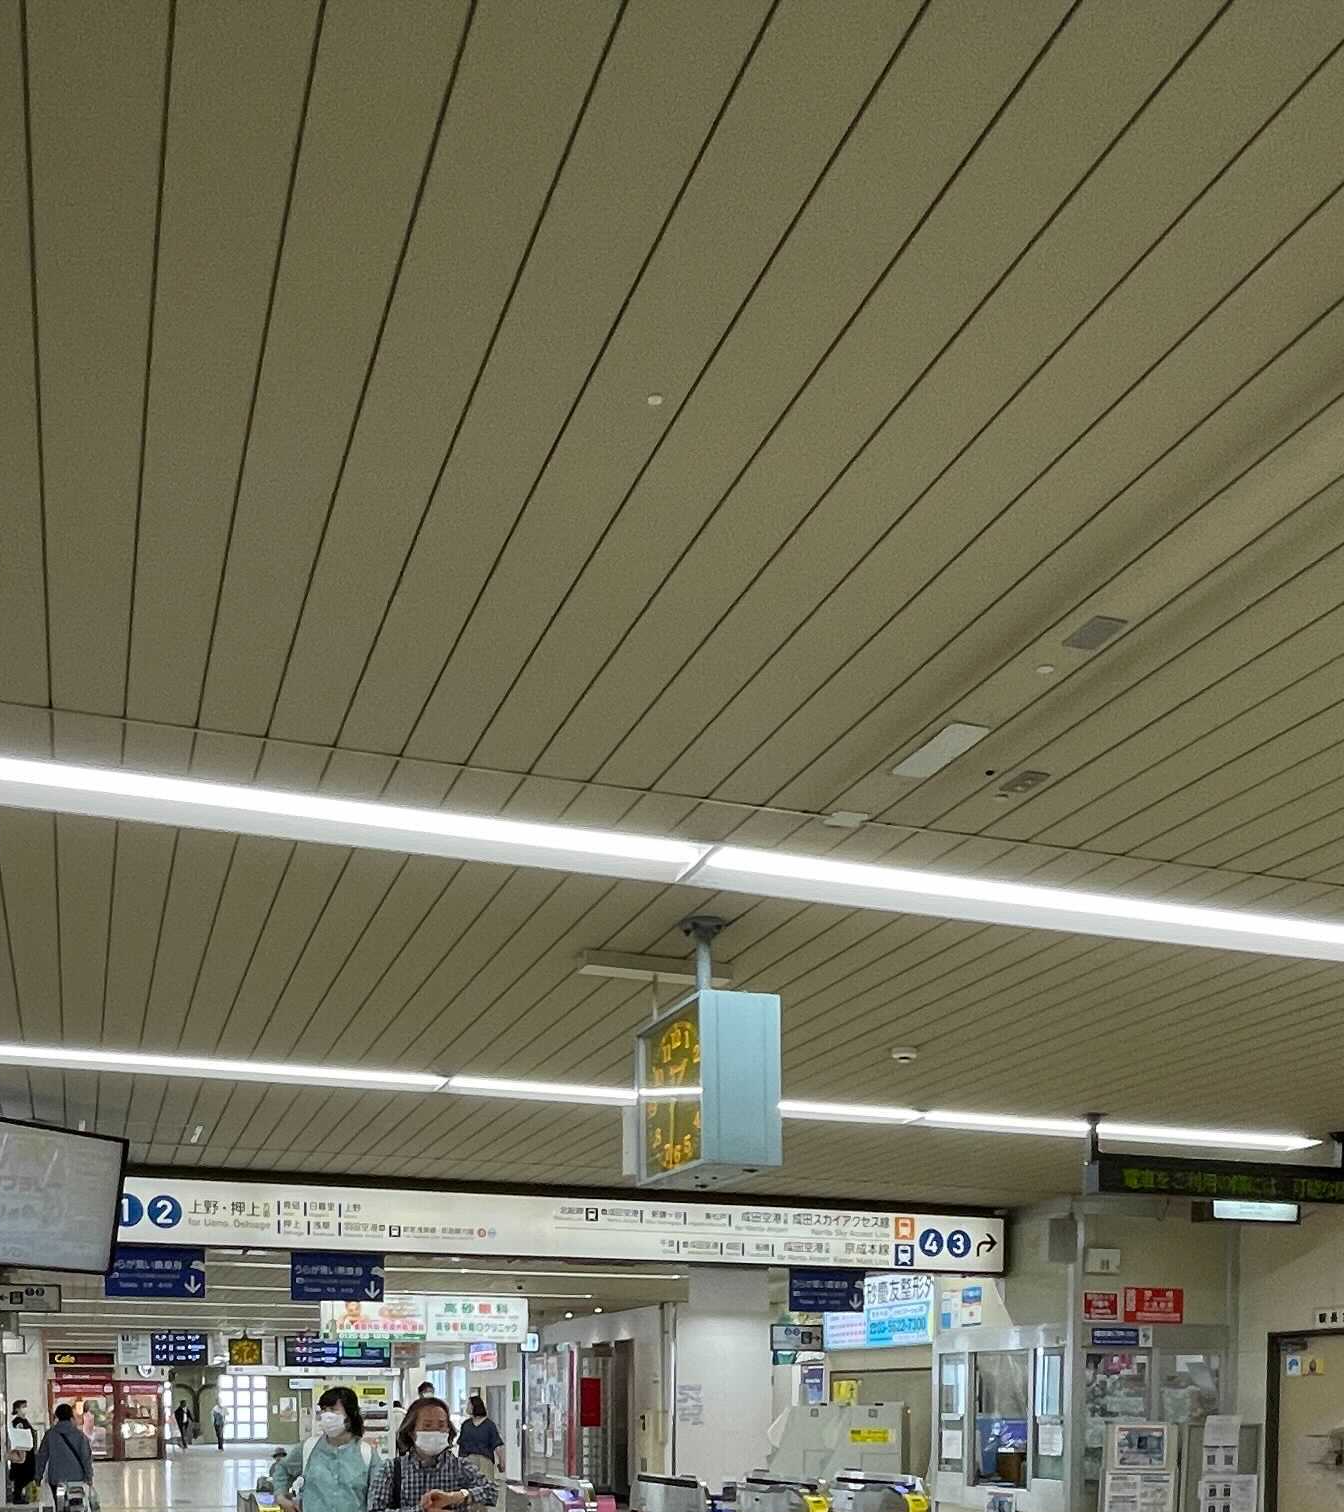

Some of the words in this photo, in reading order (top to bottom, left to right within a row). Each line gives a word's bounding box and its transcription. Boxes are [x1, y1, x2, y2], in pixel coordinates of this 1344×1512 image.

[792, 1213, 890, 1228] 成田スカイアクセス線
